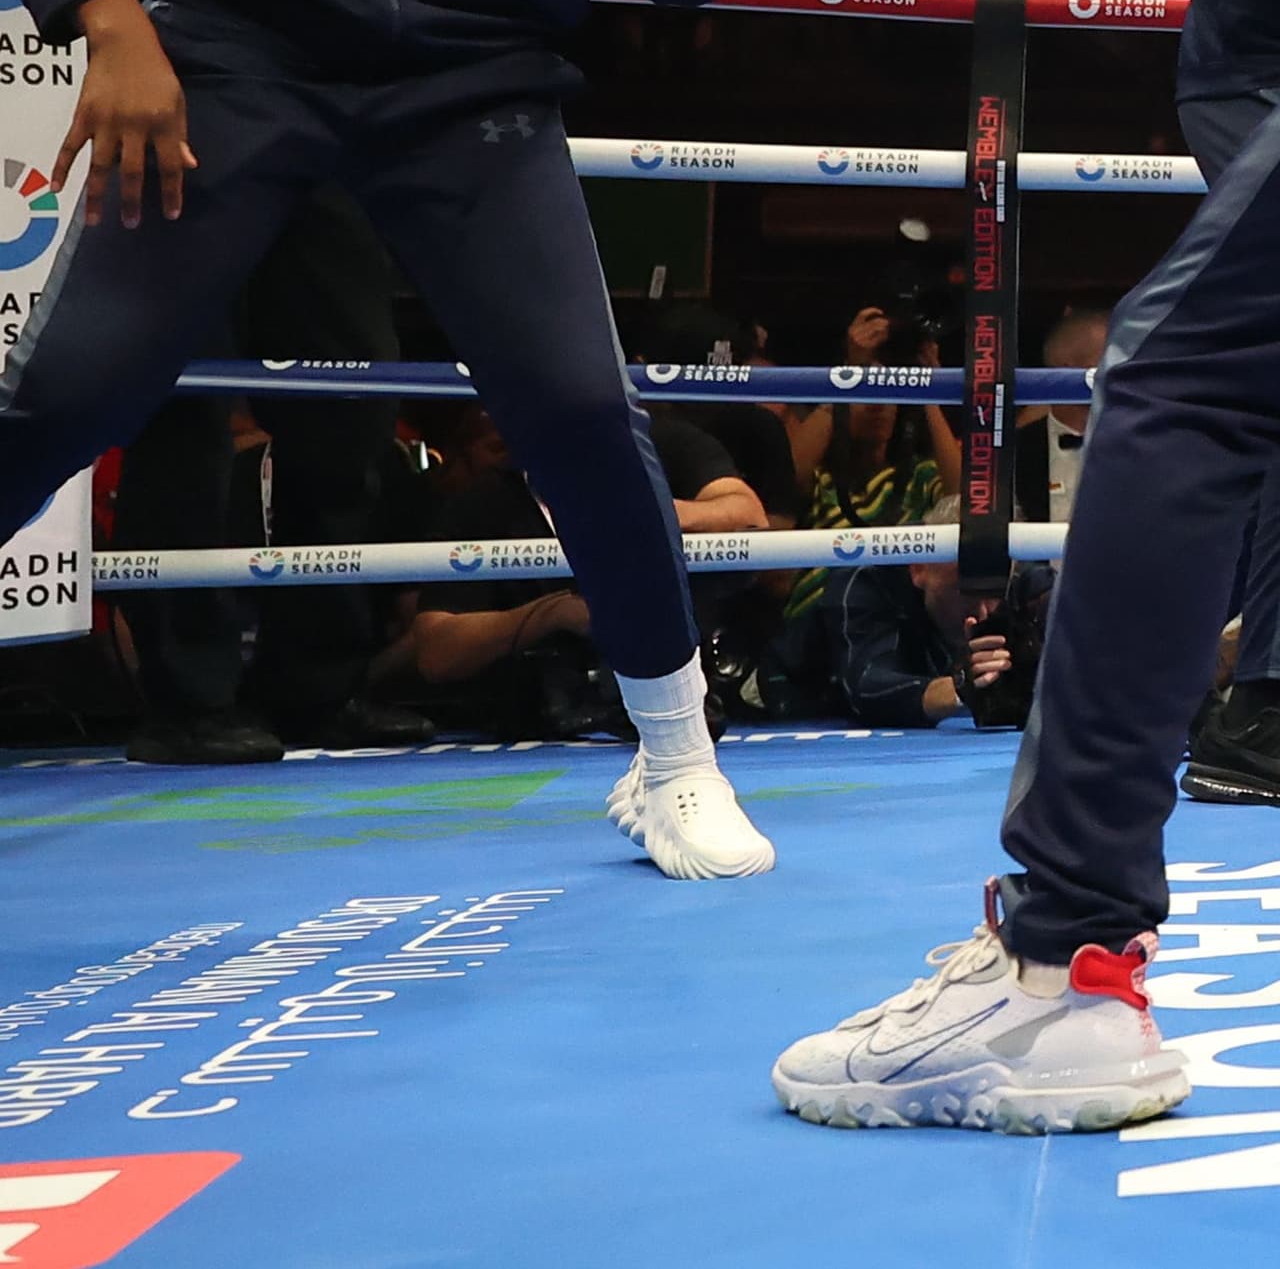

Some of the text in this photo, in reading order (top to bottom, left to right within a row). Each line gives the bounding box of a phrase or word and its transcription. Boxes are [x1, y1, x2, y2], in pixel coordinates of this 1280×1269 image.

[1105, 6, 1165, 18] SEASON
[671, 146, 736, 157] RIYADH
[856, 152, 919, 161] RIYADH
[670, 157, 735, 169] SEASON
[856, 162, 919, 174] SEASON
[1112, 159, 1173, 168] RIYADH
[1112, 168, 1172, 180] SEASON
[974, 207, 995, 292] EDITION
[684, 370, 750, 382] SEASON
[868, 366, 933, 375] RIYADH
[867, 375, 931, 387] SEASON
[969, 432, 993, 515] EDITION
[872, 532, 936, 543] RIYADH
[491, 544, 559, 555] RIYADH
[685, 538, 750, 550] RIYADH
[872, 544, 936, 556] SEASON
[291, 550, 362, 562] RIYADH
[490, 556, 558, 568] SEASON
[684, 550, 749, 562] SEASON
[291, 562, 361, 574] SEASON
[2, 581, 78, 610] SON
[318, 895, 441, 919] DR
[24, 921, 244, 999] medical group
[131, 917, 398, 1008] SULAIMAN
[64, 1011, 219, 1043] AL
